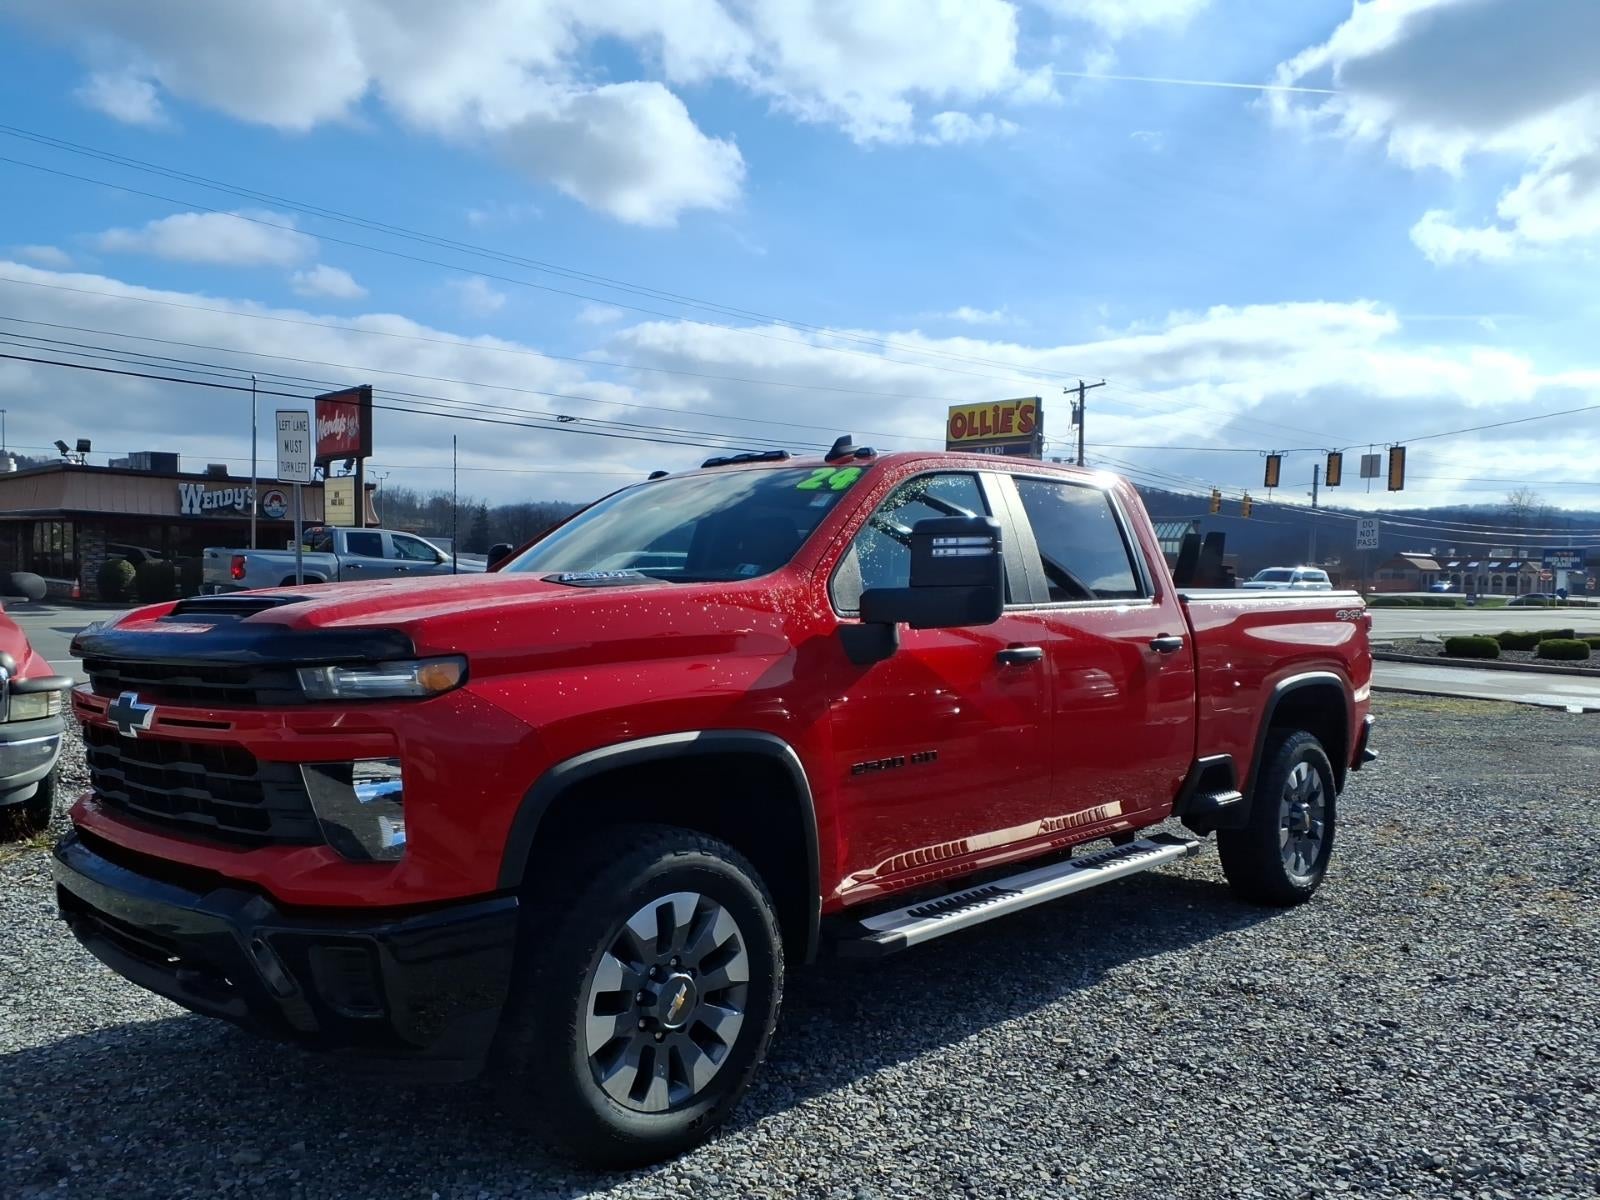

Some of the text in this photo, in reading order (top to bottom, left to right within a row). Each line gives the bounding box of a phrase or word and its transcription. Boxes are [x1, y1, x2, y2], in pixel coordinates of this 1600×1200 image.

[279, 420, 307, 432] LEFT LANE
[316, 410, 347, 443] Wendy's
[284, 439, 303, 453] MUST
[281, 461, 307, 473] TURN LEFT
[796, 467, 862, 491] 24
[1362, 520, 1374, 528] DO
[1359, 529, 1376, 538] NOT
[1357, 538, 1377, 547] PASS
